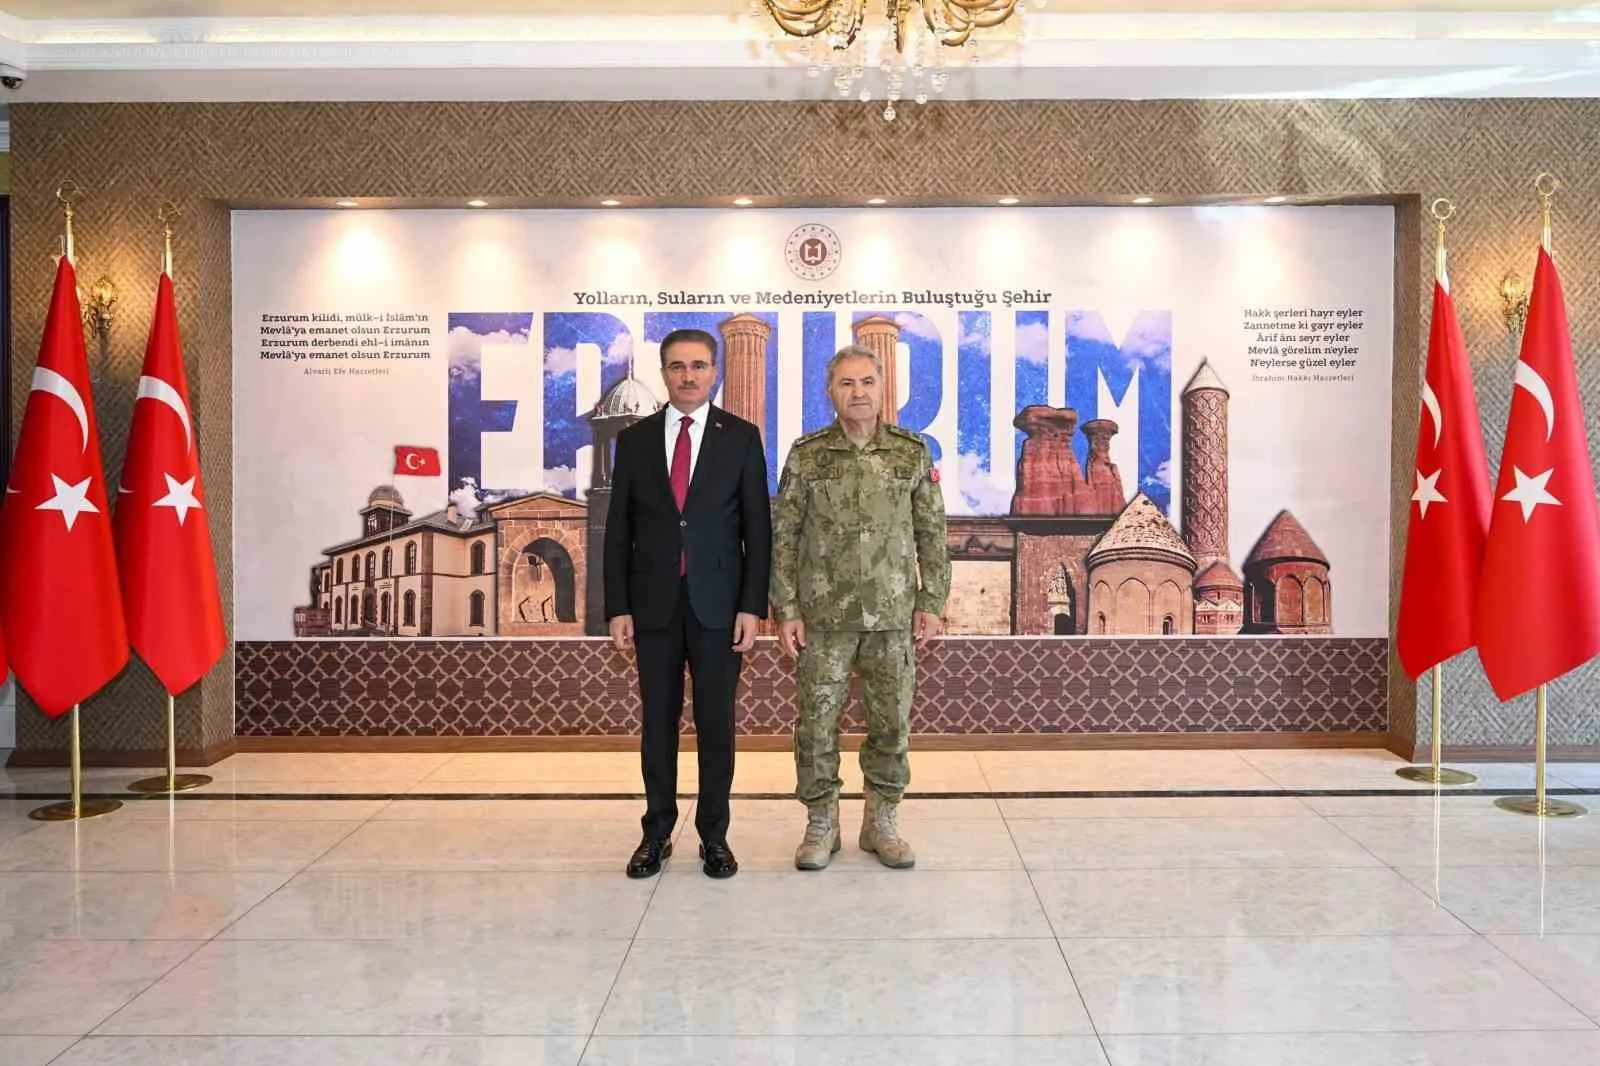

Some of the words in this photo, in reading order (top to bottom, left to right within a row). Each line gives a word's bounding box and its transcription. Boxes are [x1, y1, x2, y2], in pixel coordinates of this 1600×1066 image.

[572, 292, 653, 308] Yolların,
[656, 292, 726, 306] Suların
[728, 295, 752, 305] ve
[755, 292, 898, 309] Medeniyetlerin
[901, 292, 998, 309] Buluştuğu
[1002, 292, 1053, 309] Şehir
[262, 313, 309, 323] Erzurum
[1244, 309, 1272, 318] Hakk
[1273, 309, 1308, 320] şerleri
[1310, 309, 1335, 320] hayr
[1336, 309, 1364, 320] eyler
[308, 327, 348, 335] emanet
[350, 326, 381, 335] olsun
[383, 326, 431, 335] Erzurum
[1243, 321, 1296, 330] Zannetme
[1297, 321, 1309, 330] ki
[1311, 322, 1335, 332] gayr
[1336, 321, 1364, 332] eyler
[261, 338, 309, 347] Erzurum
[311, 338, 358, 348] derbendi
[1298, 335, 1321, 344] seyr
[1322, 334, 1350, 345] eyler
[308, 352, 348, 360] emanet
[350, 351, 381, 360] olsun
[383, 351, 431, 360] Erzurum
[1281, 346, 1322, 357] görelim
[1298, 358, 1327, 369] güzel
[1329, 358, 1357, 369] eyler
[449, 312, 1172, 517] ERUM
